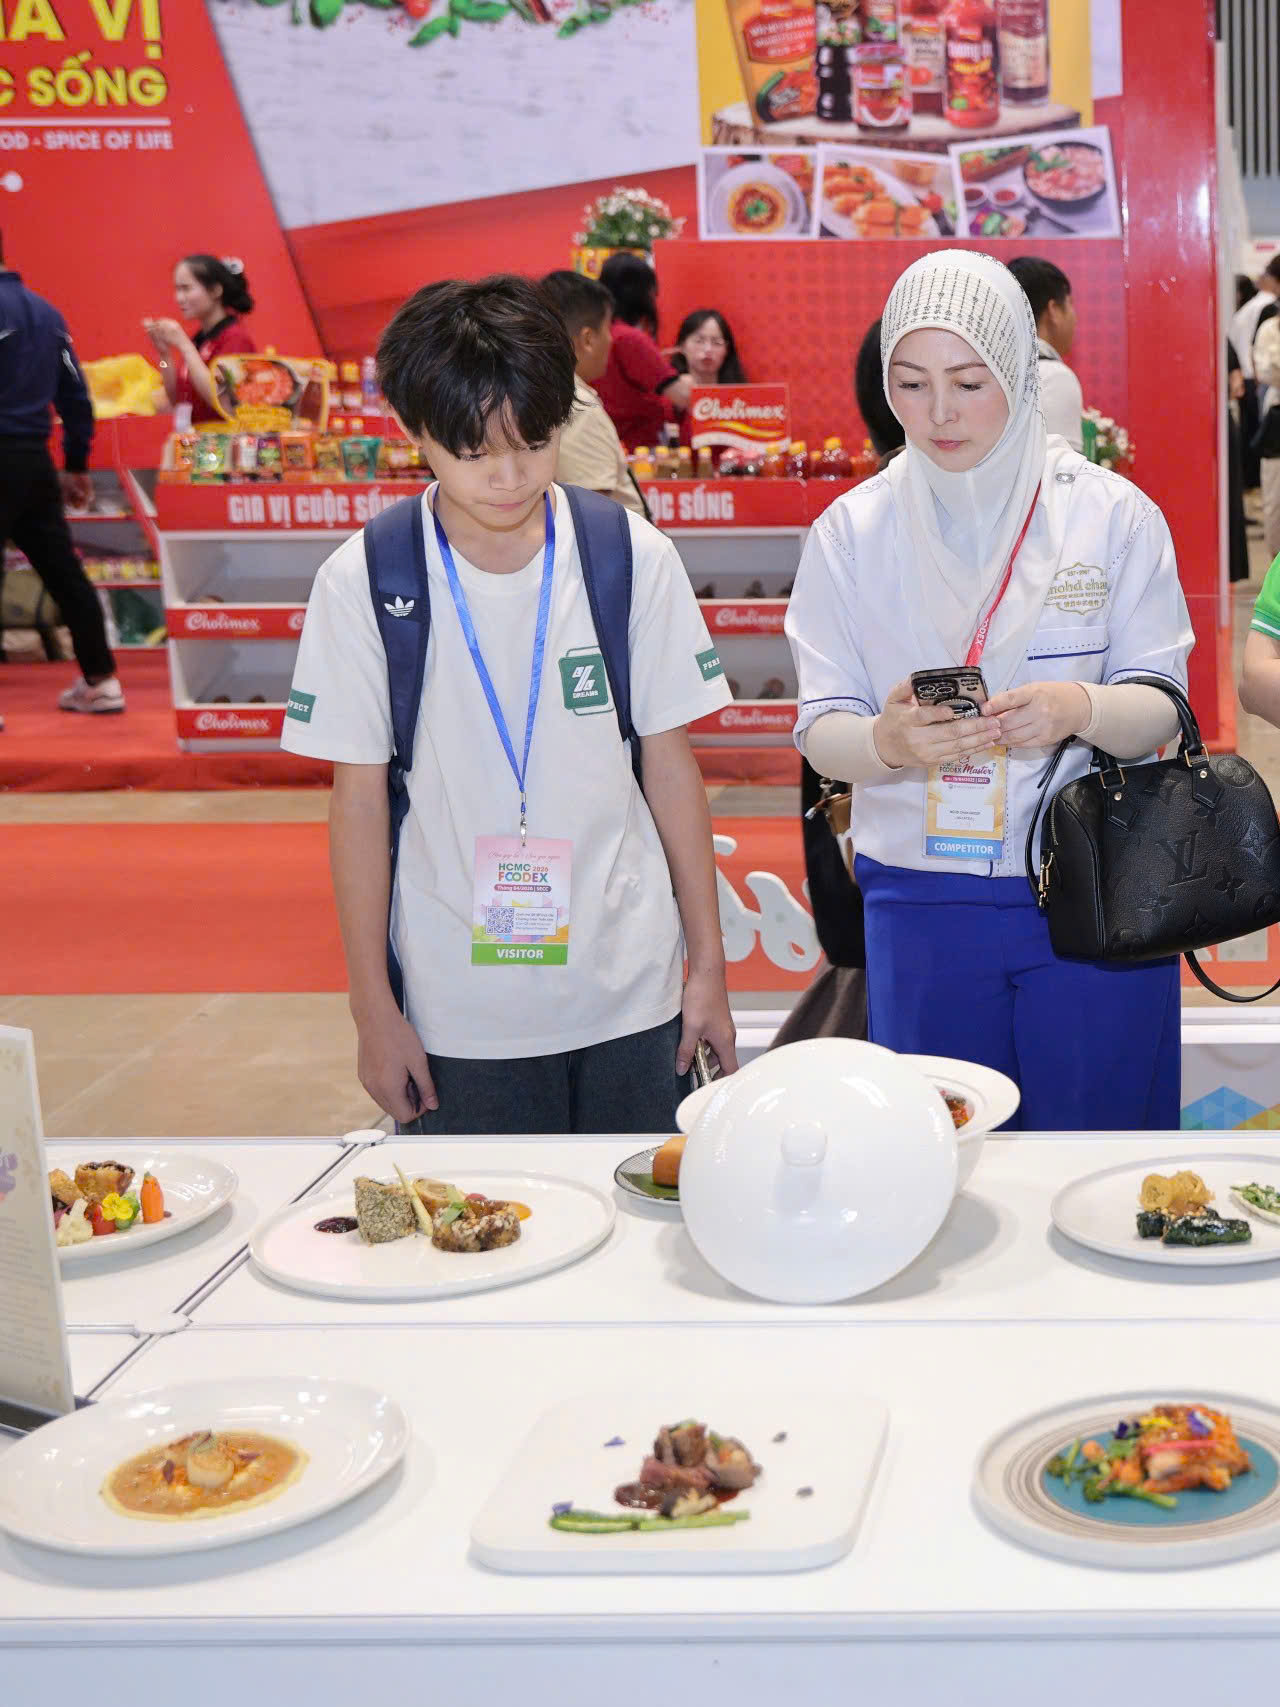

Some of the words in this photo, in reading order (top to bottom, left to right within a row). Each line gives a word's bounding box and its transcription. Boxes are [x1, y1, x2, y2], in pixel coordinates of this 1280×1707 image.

[88, 0, 163, 60] VỊ
[27, 50, 168, 107] SỐNG
[43, 130, 100, 150] SPICE
[104, 130, 133, 149] OF
[136, 130, 173, 150] LIFE
[691, 396, 787, 422] Cholimex
[228, 494, 266, 525] GIA
[269, 494, 293, 528] VỊ
[296, 487, 350, 528] CUỘC
[679, 483, 735, 521] SỐNG
[186, 611, 261, 631] Cholimex
[196, 712, 270, 731] Cholimex
[719, 708, 793, 728] Cholimex
[934, 842, 994, 855] COMPETITOR
[498, 863, 531, 872] HCMC
[496, 948, 544, 959] VISITOR
